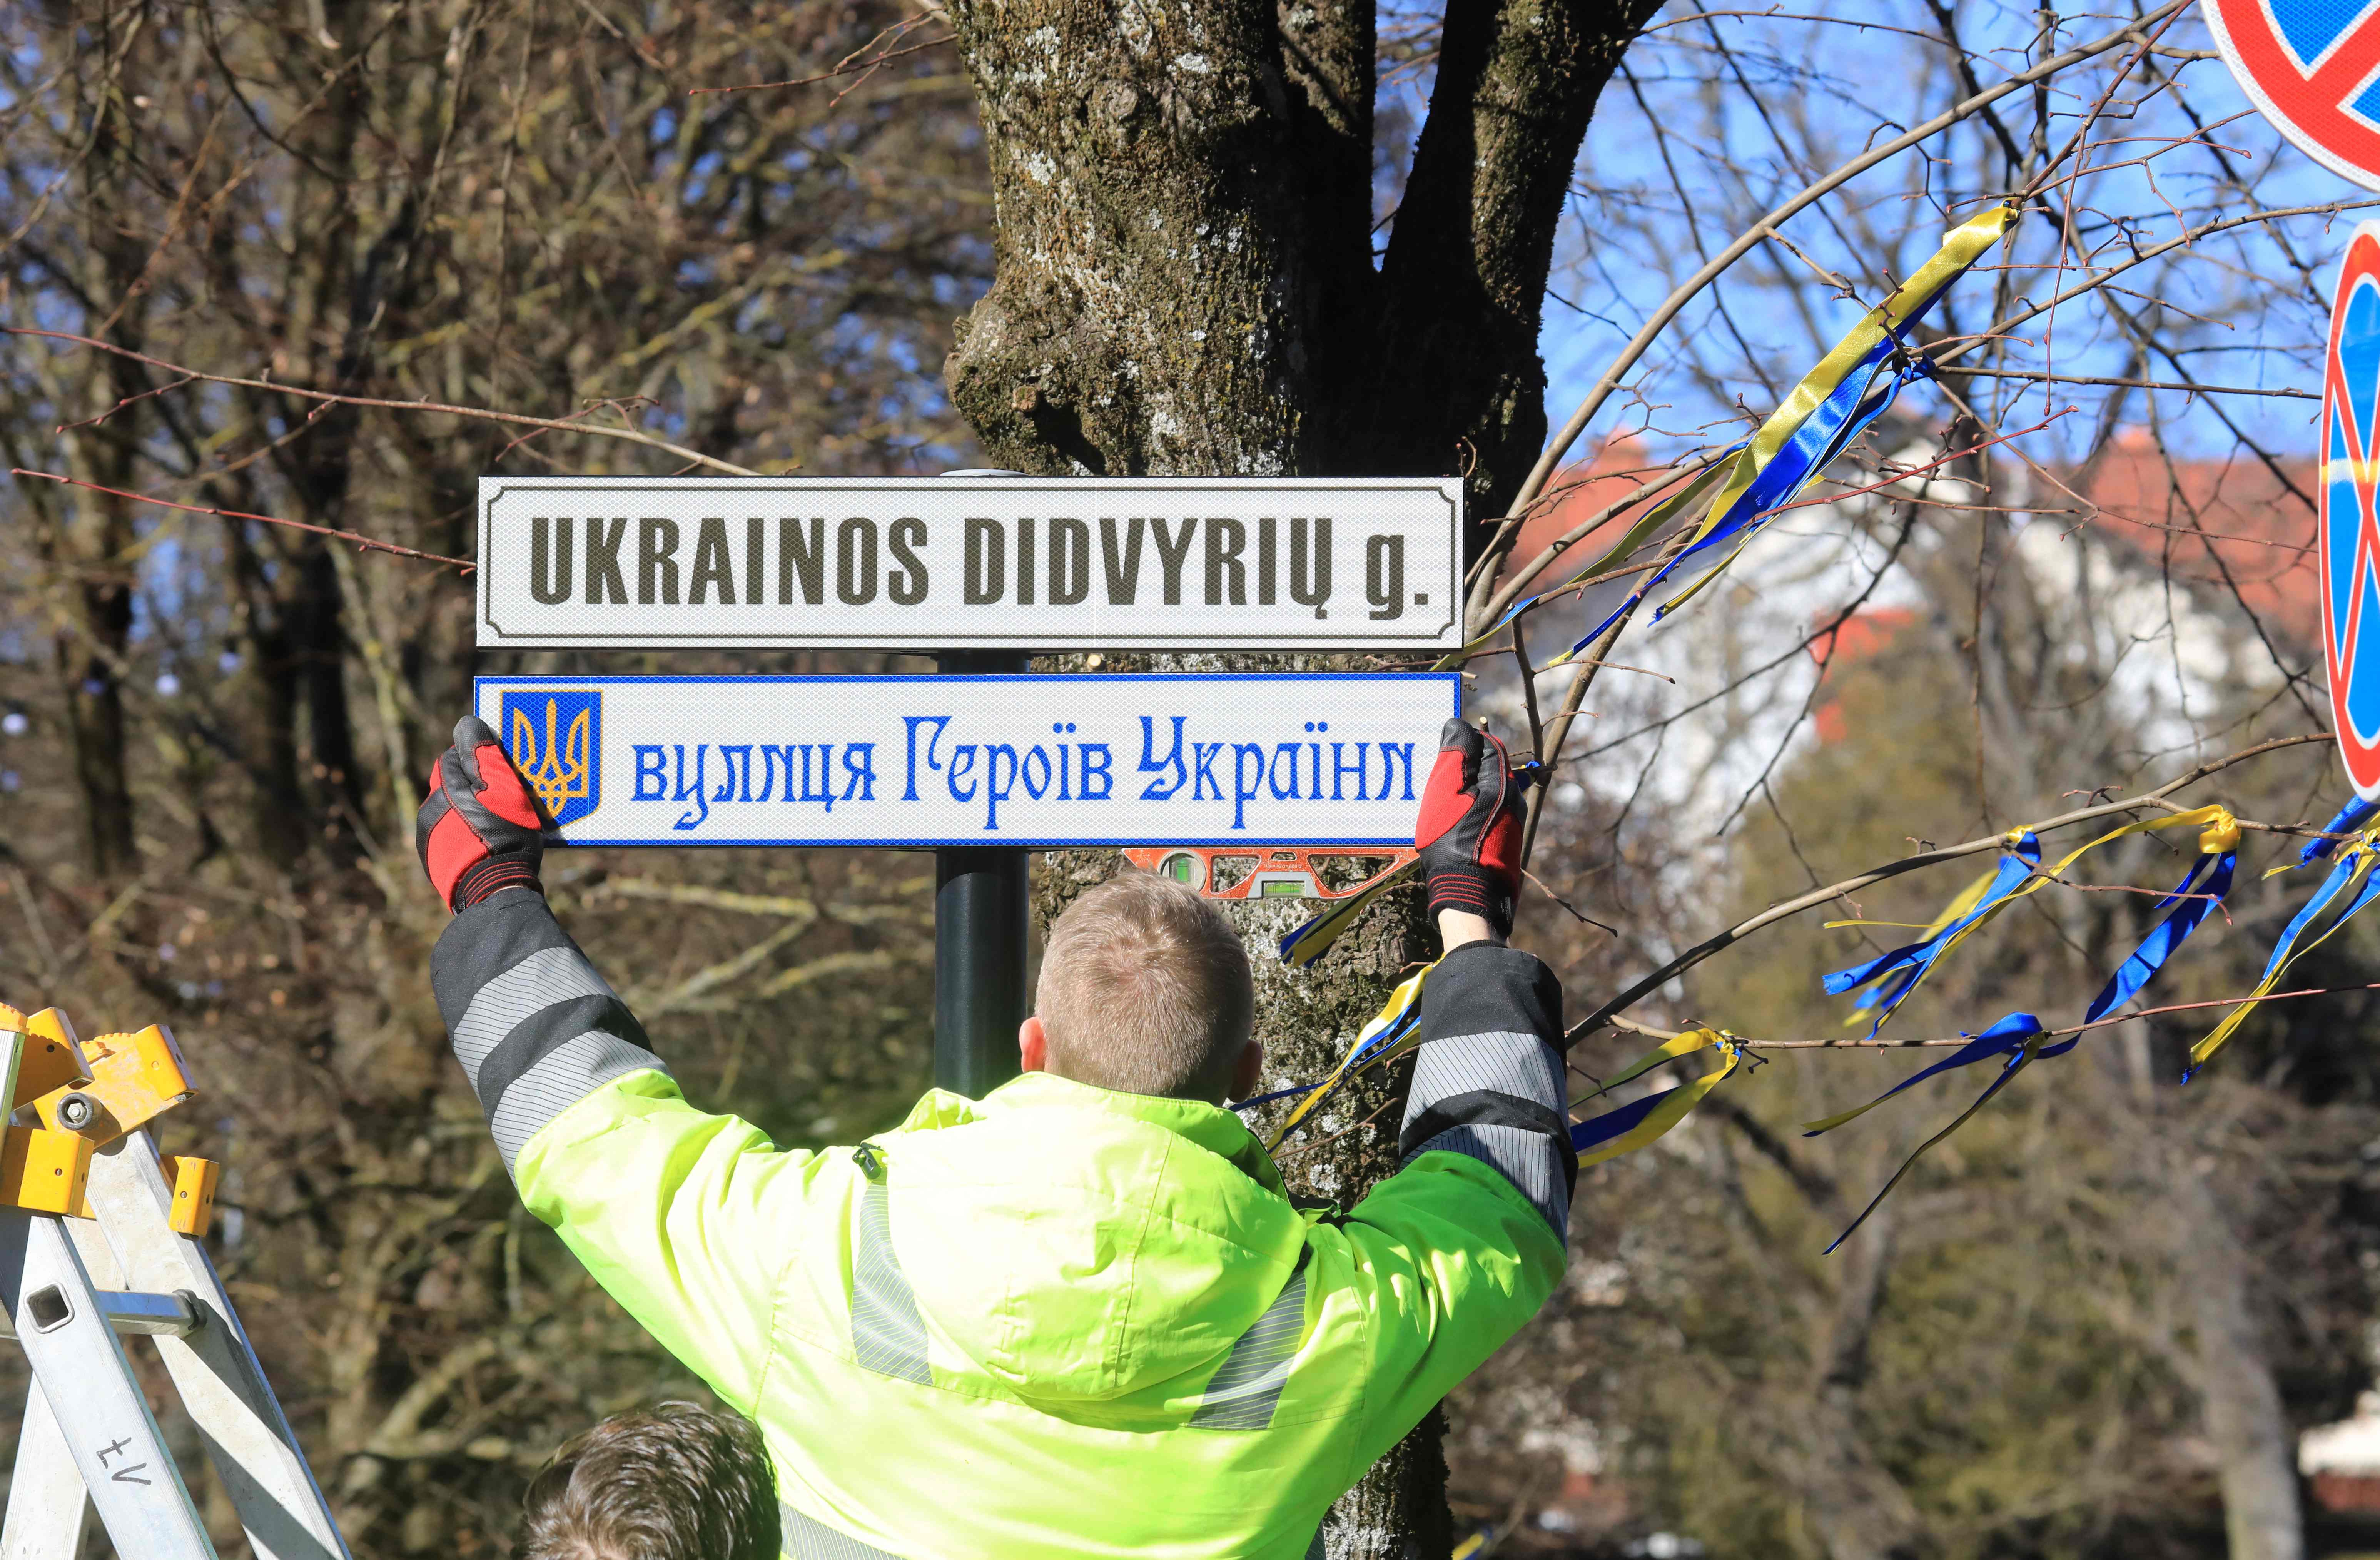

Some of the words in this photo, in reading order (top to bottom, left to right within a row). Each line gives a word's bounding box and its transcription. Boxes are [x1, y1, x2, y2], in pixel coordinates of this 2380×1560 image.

[531, 517, 929, 606] UKRAINOS
[964, 518, 1332, 620] DIDVYRIŲ
[1366, 534, 1428, 621] g.
[630, 743, 877, 831] вулиця
[902, 716, 1113, 830] Героїв
[1137, 716, 1416, 830] України
